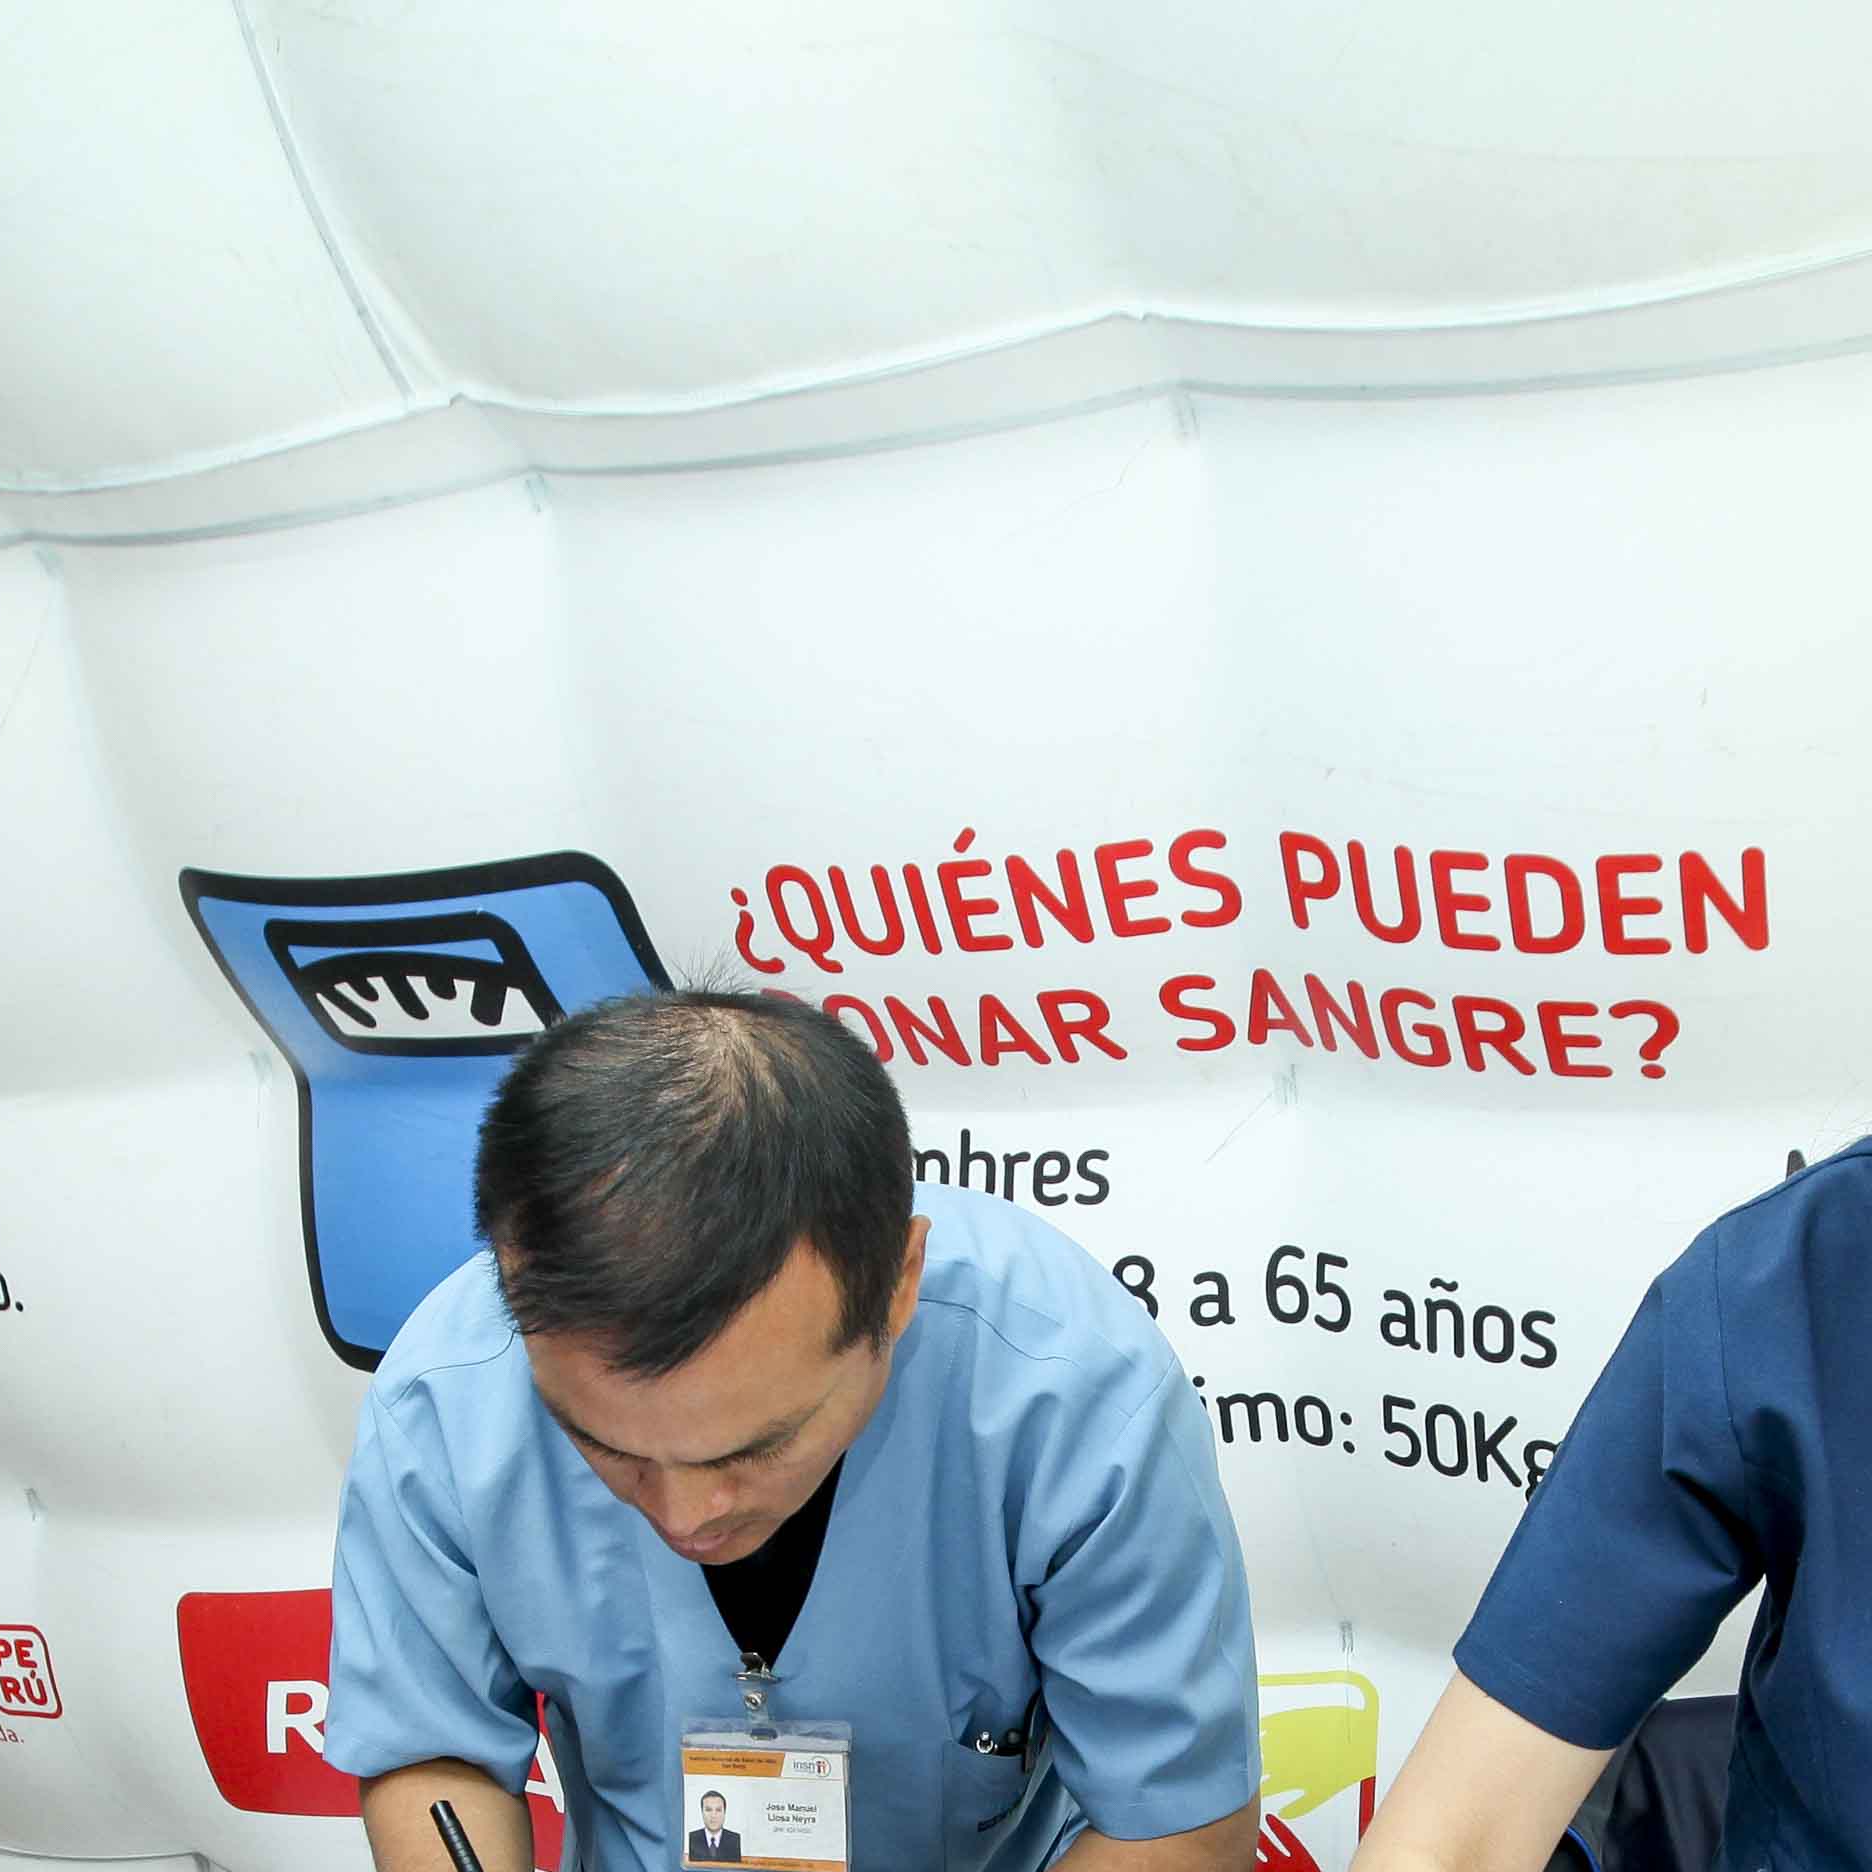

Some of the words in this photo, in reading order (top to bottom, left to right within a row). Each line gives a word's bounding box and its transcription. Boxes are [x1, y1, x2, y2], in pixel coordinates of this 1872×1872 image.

[730, 827, 1242, 973] ¿QUIÉNES
[1279, 831, 1769, 955] PUEDEN
[1158, 968, 1680, 1078] SANGRE?
[913, 1128, 1111, 1207] mbres
[1112, 1254, 1159, 1321] 8
[1190, 1271, 1236, 1327] a
[1265, 1244, 1352, 1333] 65
[1380, 1277, 1559, 1370] años
